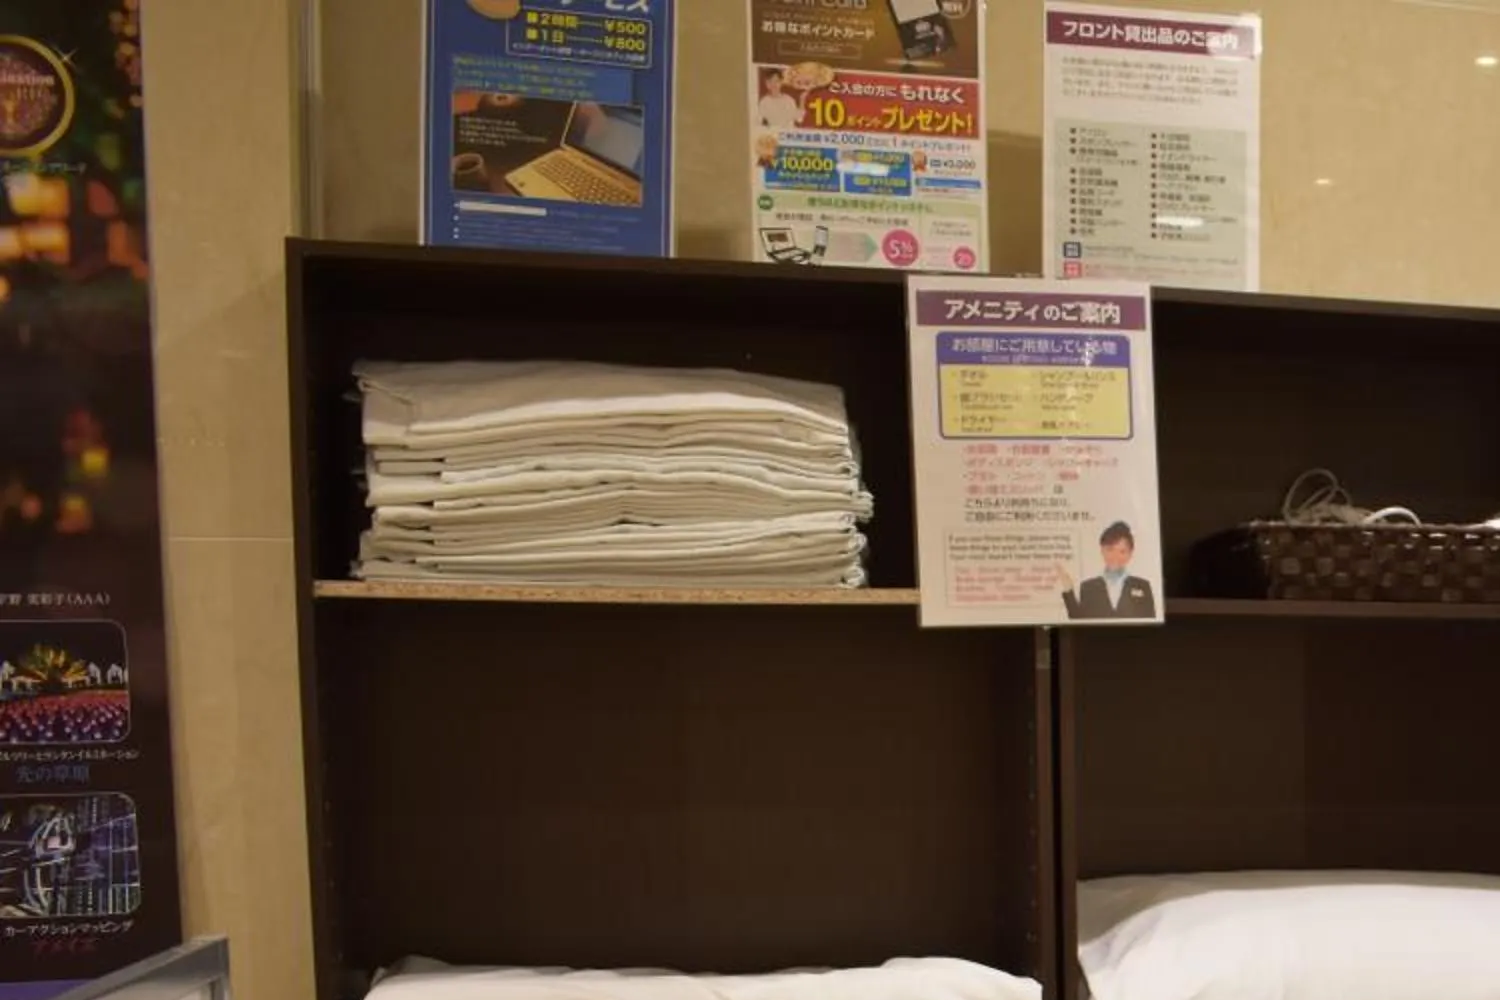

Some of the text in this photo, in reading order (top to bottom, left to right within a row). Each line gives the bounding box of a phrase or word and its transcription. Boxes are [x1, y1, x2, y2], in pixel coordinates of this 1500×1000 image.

[1061, 20, 1239, 50] フロント貸出品のご案内
[900, 85, 965, 103] もれなく
[944, 298, 1121, 325] アメニティのご案内
